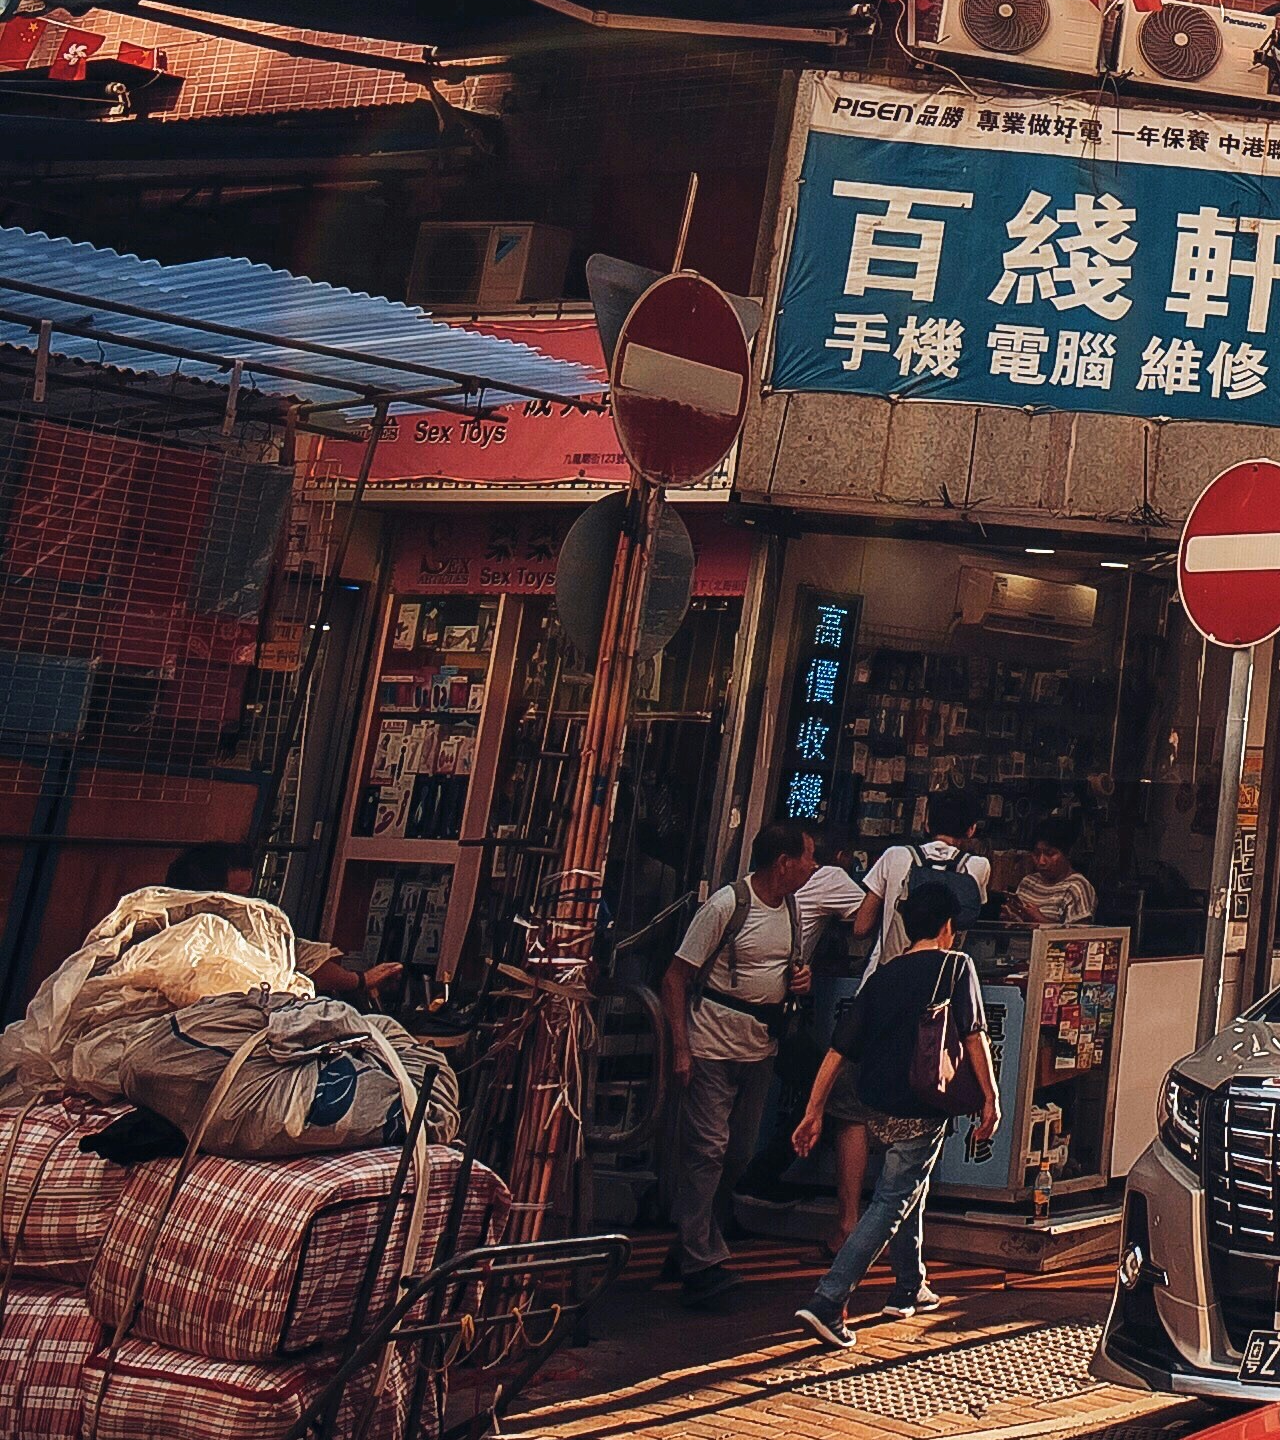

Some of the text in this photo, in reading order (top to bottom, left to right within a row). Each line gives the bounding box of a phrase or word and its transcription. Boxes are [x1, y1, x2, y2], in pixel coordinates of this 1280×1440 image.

[1223, 16, 1267, 30] Panasonic
[915, 105, 964, 128] 品勝
[1112, 124, 1209, 153] 一年保養
[825, 313, 1268, 400] 手機 電腦 維修
[413, 420, 451, 443] Sex
[479, 566, 511, 587] Sex
